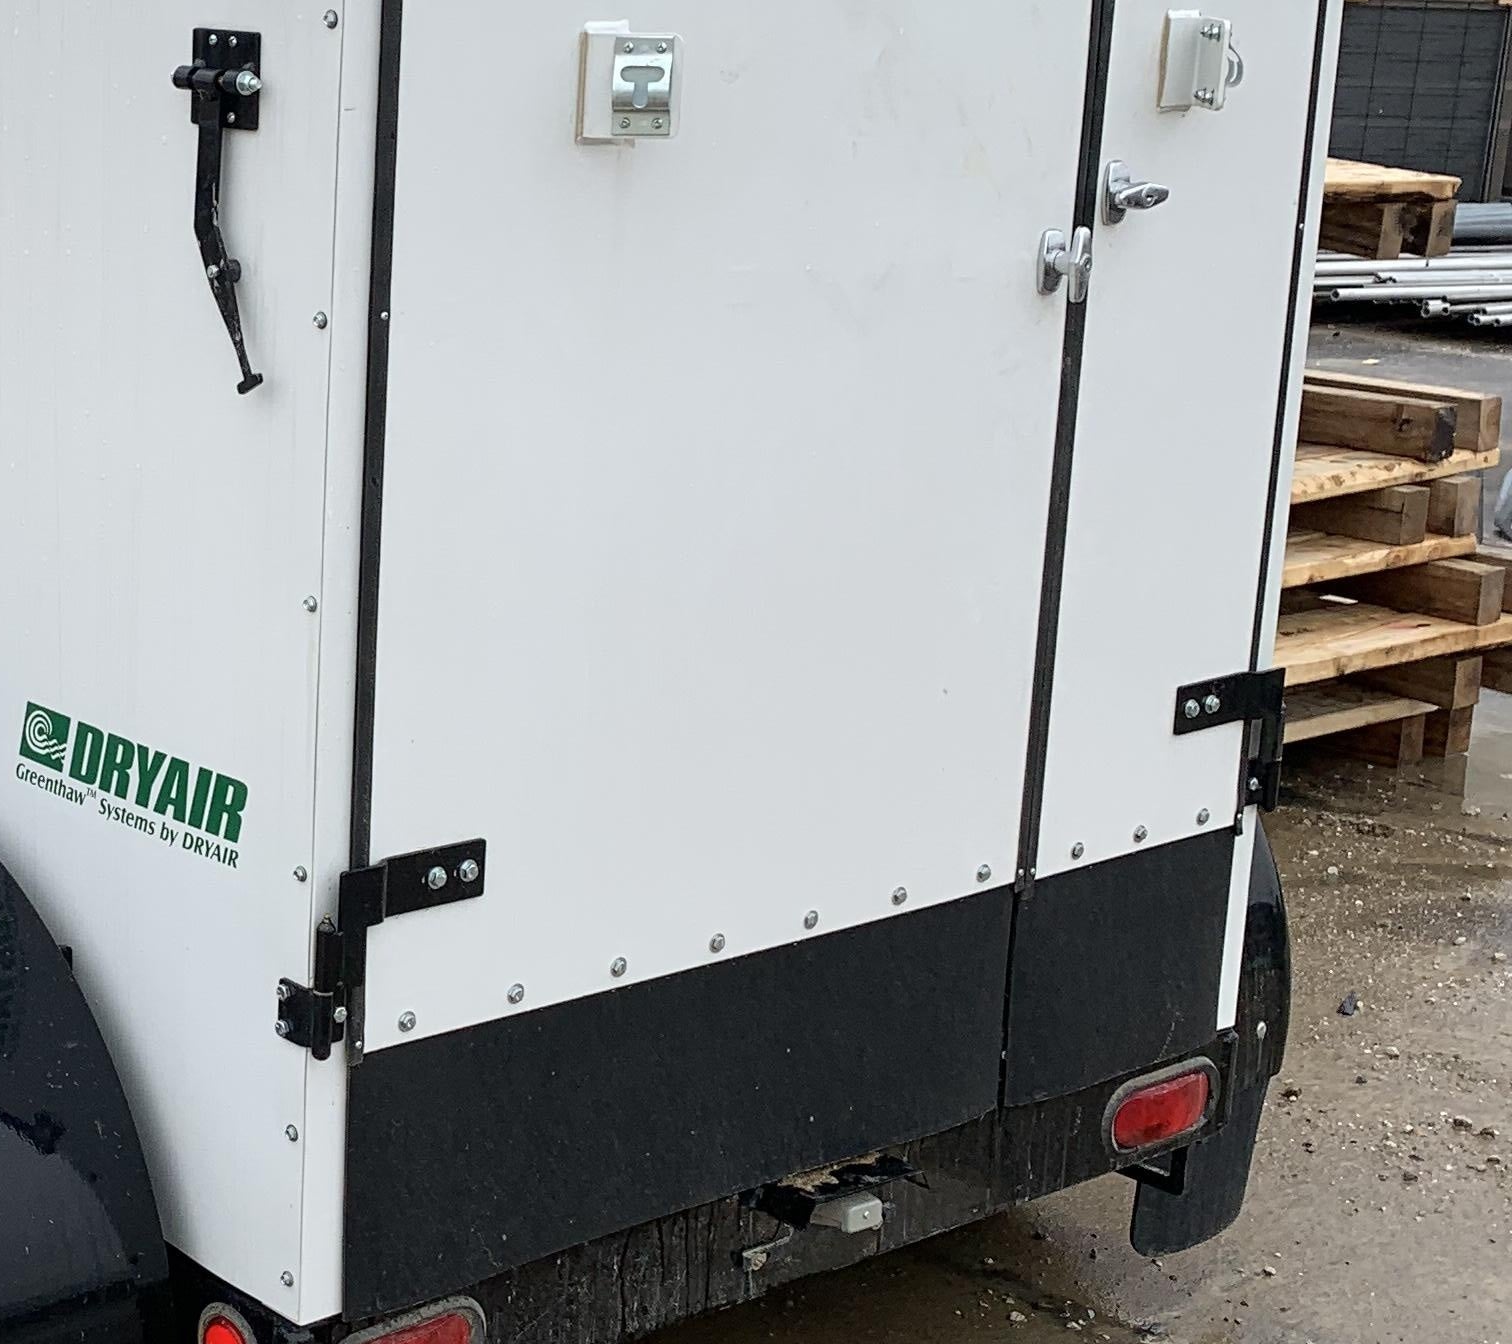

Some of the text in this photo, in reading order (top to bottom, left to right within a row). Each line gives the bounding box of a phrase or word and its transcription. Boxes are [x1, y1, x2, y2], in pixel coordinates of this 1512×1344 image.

[68, 720, 249, 844] DRYAIR
[98, 798, 156, 835] Systems
[160, 821, 179, 847] by
[181, 831, 240, 869] DRYAIR
